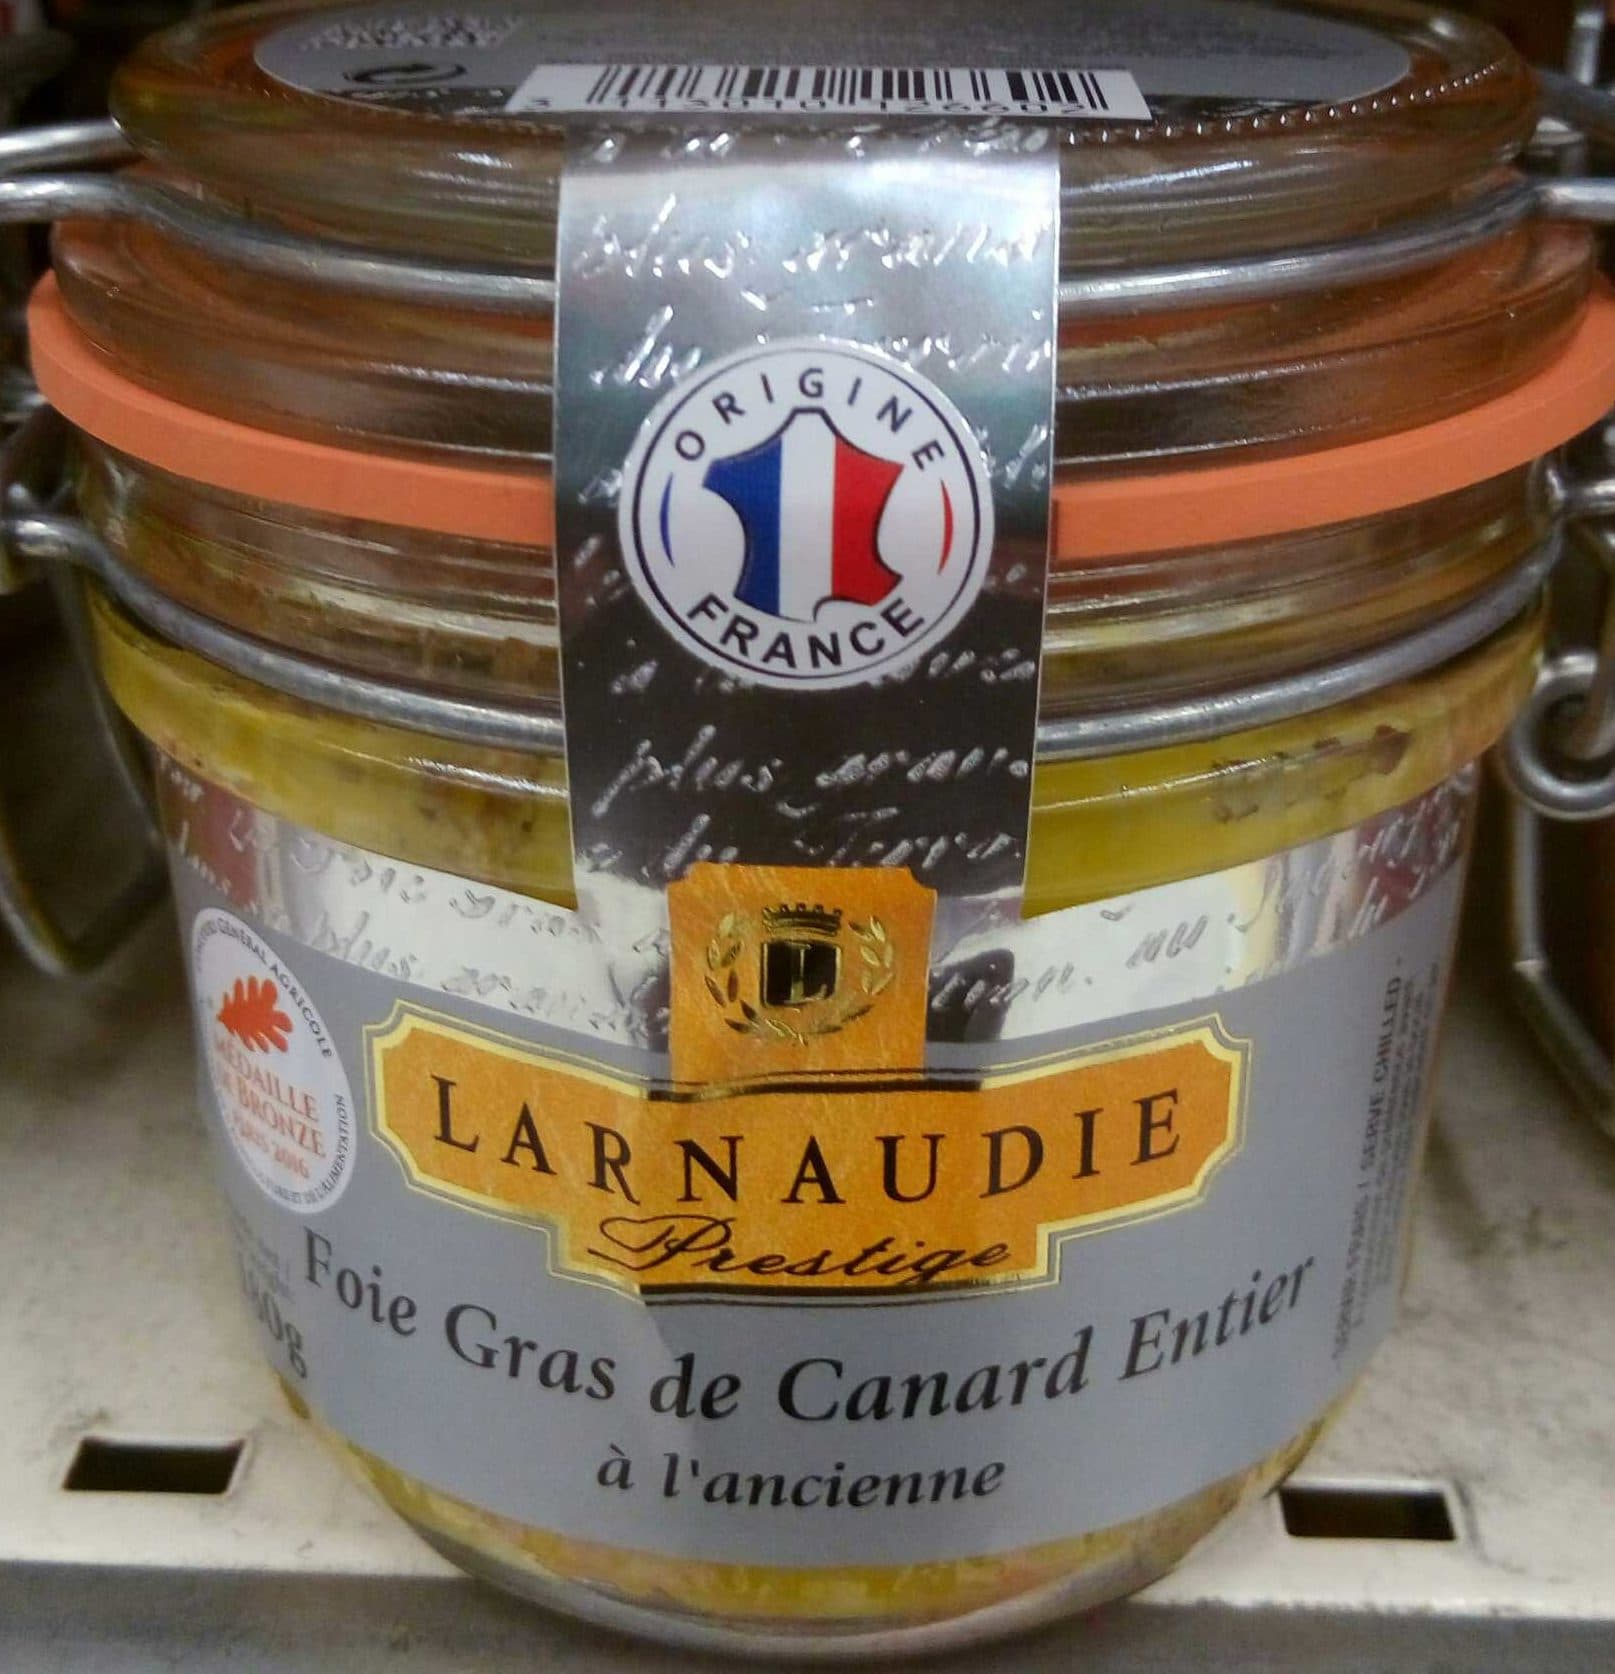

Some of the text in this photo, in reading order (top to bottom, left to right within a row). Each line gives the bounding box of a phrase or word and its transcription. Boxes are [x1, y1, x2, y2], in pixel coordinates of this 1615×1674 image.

[675, 368, 945, 472] ORIGINE
[687, 593, 925, 668] FRANCE
[268, 962, 333, 1058] AGRICOLE
[1372, 975, 1402, 1085] CHILLED
[237, 1073, 326, 1159] BRONZE
[430, 1073, 1181, 1205] LARNAUDIE
[1360, 1092, 1386, 1173] SERVE
[587, 1213, 1012, 1286] Prestige
[303, 1225, 417, 1337] Foie
[444, 1303, 617, 1401] Gras
[649, 1352, 742, 1421] de
[776, 1324, 1095, 1421] Canard
[1117, 1255, 1315, 1382] Entier
[596, 1443, 1006, 1508] à l'ancienne
